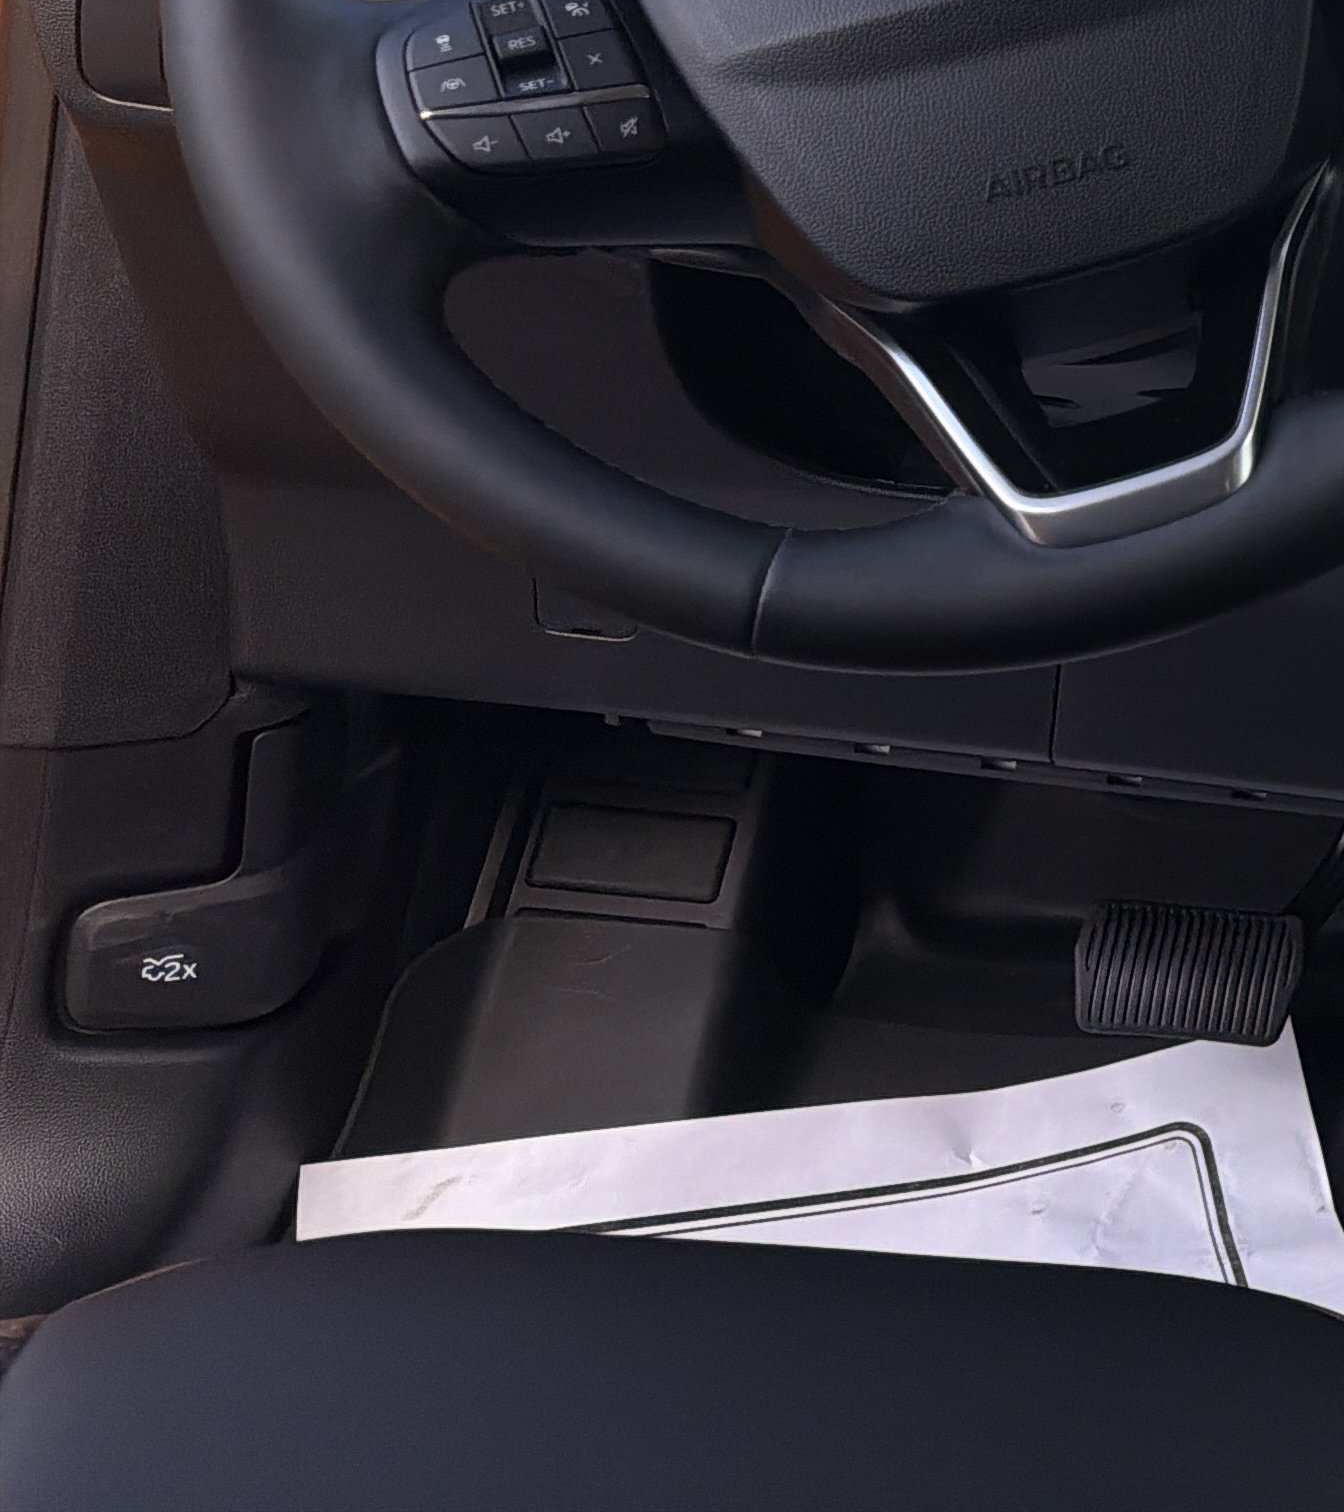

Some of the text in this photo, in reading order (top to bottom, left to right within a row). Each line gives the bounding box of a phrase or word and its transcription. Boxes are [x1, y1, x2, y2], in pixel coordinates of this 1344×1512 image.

[507, 35, 537, 51] RES
[986, 144, 1129, 204] AIRBAG
[164, 961, 198, 982] 2x
